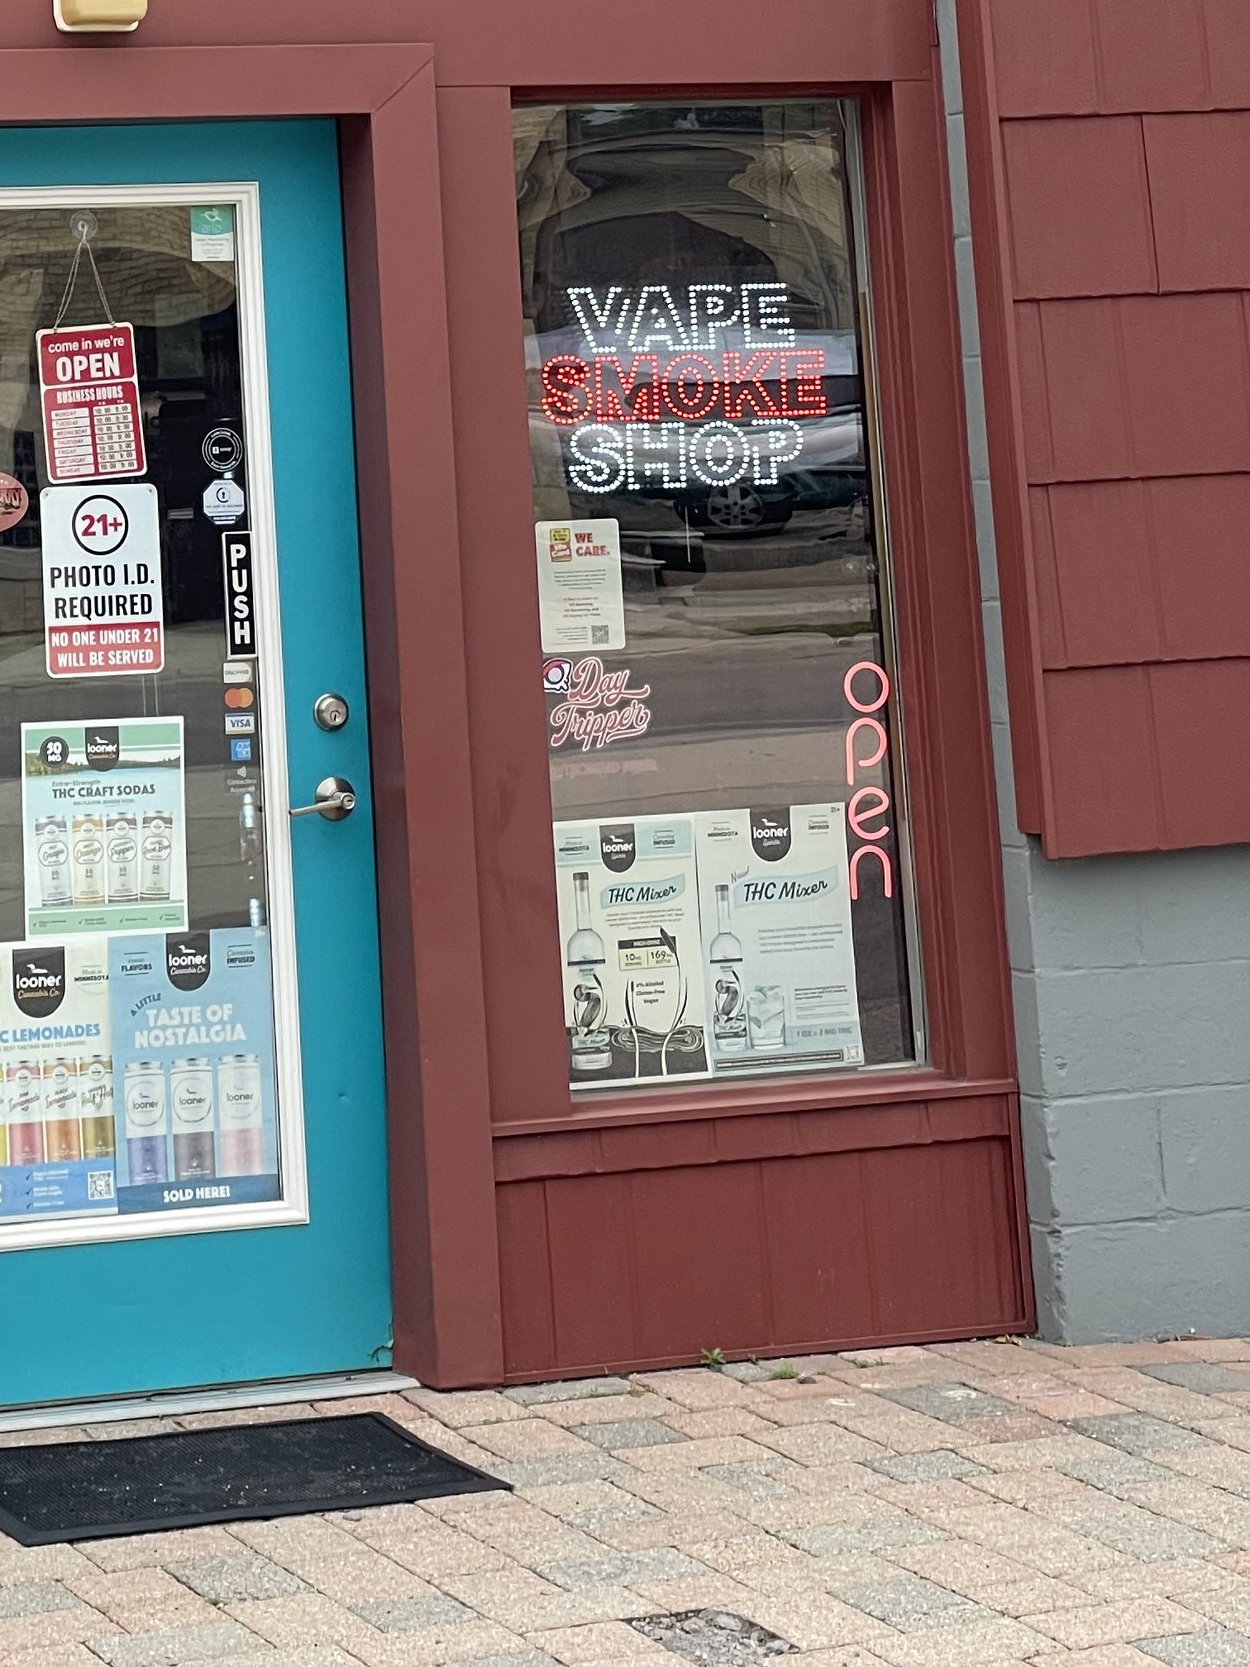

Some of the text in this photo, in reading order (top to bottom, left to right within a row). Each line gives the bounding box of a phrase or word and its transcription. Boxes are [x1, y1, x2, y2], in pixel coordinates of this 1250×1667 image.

[566, 283, 796, 353] VAPE
[48, 335, 125, 353] come in we're
[56, 352, 121, 382] OPEN
[57, 385, 124, 404] BUSINESS HOURS
[540, 348, 828, 426] SMOKE
[567, 418, 804, 494] SHOP
[81, 513, 123, 537] 21+
[574, 532, 593, 544] WE
[576, 545, 610, 557] CARE.
[50, 563, 155, 589] PHOTO I.D.
[229, 543, 251, 645] PUSH
[54, 593, 153, 621] REQUIRED
[51, 627, 158, 647] NO ONE UNDER 21
[57, 649, 154, 668] WILL BE SERVED
[568, 656, 651, 707] Day
[230, 719, 251, 728] VISA
[550, 694, 651, 752] Tripper
[46, 741, 117, 754] 50 looner
[842, 660, 893, 902] open
[52, 783, 156, 799] THC CRAFT SODAS
[752, 826, 789, 839] looner
[602, 842, 634, 853] looner
[608, 885, 677, 904] THC Mixer
[743, 880, 828, 903] THC Mixer
[121, 963, 152, 973] FLAVORS
[168, 954, 208, 967] looner
[15, 974, 62, 990] looner
[135, 992, 162, 1010] LITTLE
[145, 1002, 233, 1028] TASTE OF
[12, 1023, 101, 1043] LEMONADES
[134, 1022, 247, 1050] NOSTALGIA
[163, 1185, 231, 1203] SOLD HERE!
